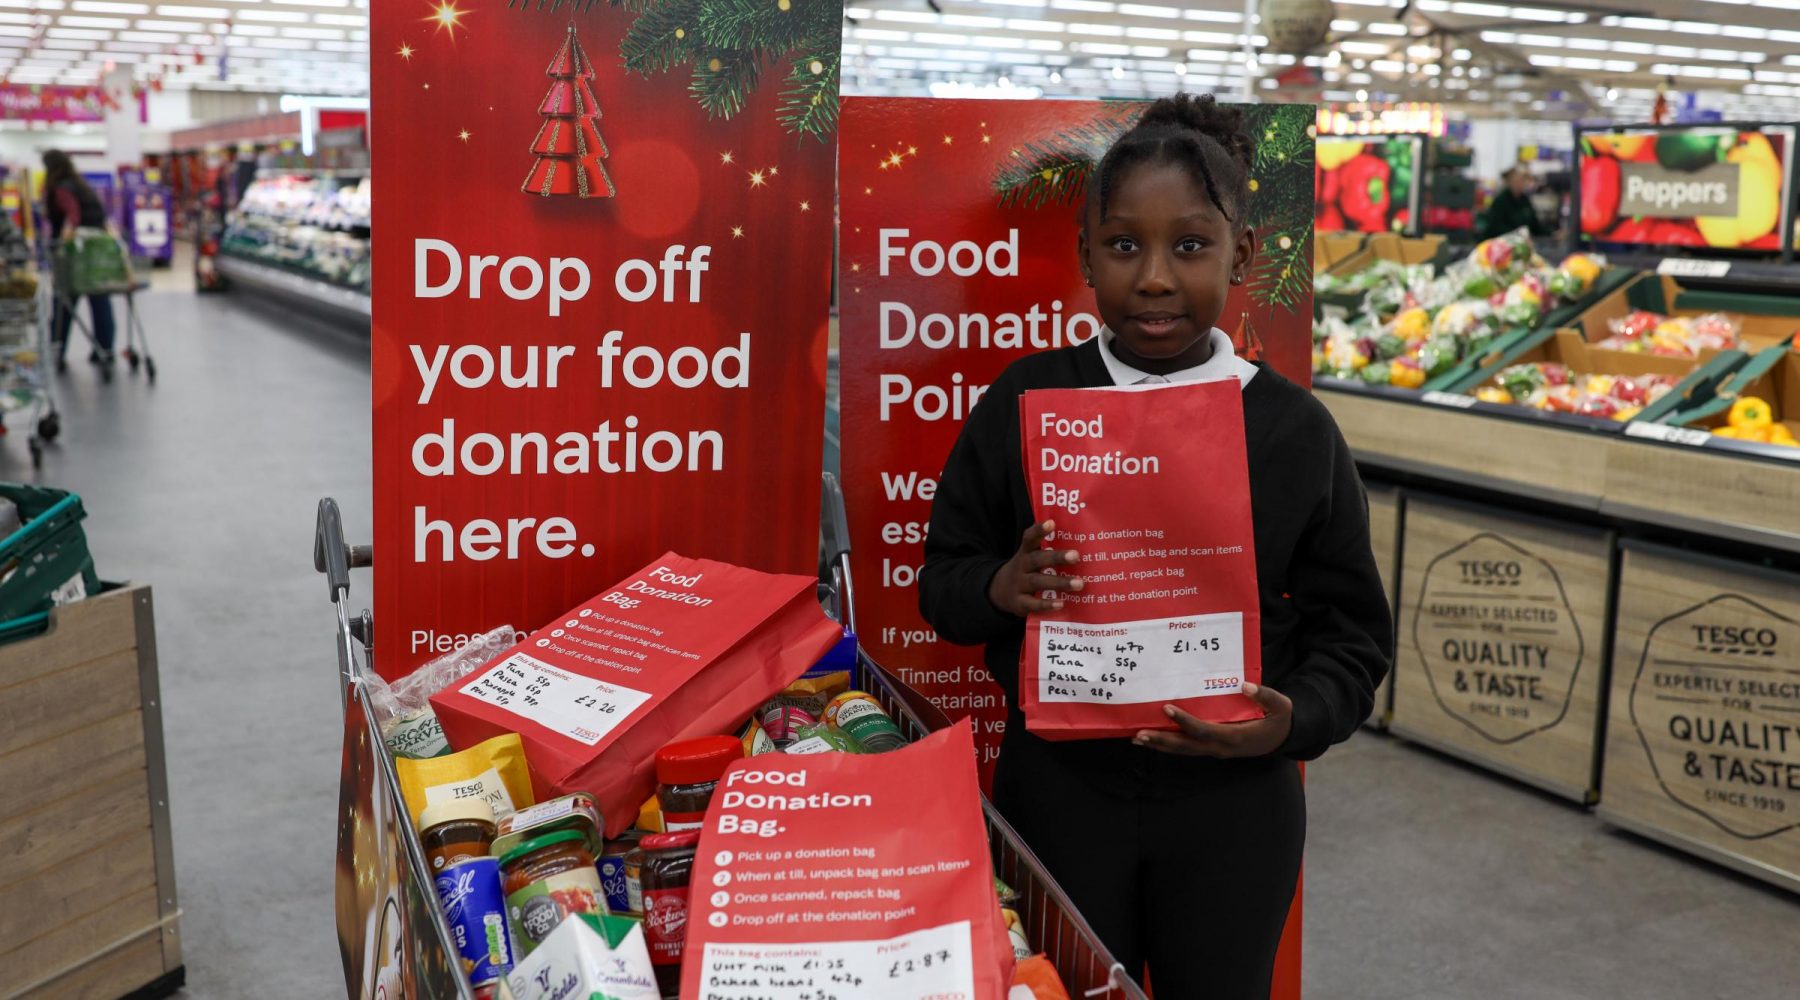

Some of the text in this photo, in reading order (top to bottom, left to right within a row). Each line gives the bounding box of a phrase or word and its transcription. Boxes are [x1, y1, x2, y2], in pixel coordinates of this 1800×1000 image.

[1627, 175, 1728, 209] Peppers
[879, 228, 1019, 277] Food
[414, 238, 711, 317] Drop off
[880, 300, 1100, 349] Donatio
[409, 330, 751, 405] your food
[880, 372, 990, 421] Poi
[1041, 413, 1103, 439] Food
[411, 415, 724, 476] donation
[1041, 448, 1159, 475] Donation
[1042, 482, 1087, 514] Bag.
[414, 505, 596, 563] here.
[1057, 528, 1164, 543] Pick up a donation bag
[1082, 553, 1092, 562] at
[1111, 549, 1146, 562] unpack
[1149, 547, 1167, 559] bag
[1169, 546, 1188, 556] and
[1190, 547, 1214, 556] scan
[1216, 545, 1243, 555] items
[648, 566, 703, 588] Food
[1130, 568, 1163, 582] repack
[1166, 567, 1185, 577] bag
[1458, 561, 1522, 579] TESCO
[602, 591, 642, 609] Bag.
[625, 580, 713, 607] Donation
[1061, 586, 1198, 604] Drop off at the donation point
[1493, 607, 1558, 623] SELECTED
[1044, 625, 1128, 637] This bag contains:
[1169, 621, 1196, 630] Price:
[882, 627, 896, 644] If
[1692, 624, 1777, 647] TESCO
[1047, 639, 1144, 654] Sardines 47p
[1173, 637, 1220, 653] £1.95
[1442, 639, 1549, 669] QUALITY
[506, 662, 525, 678] Tuna
[1047, 654, 1138, 671] Tuna 55p
[493, 670, 518, 687] Pasta
[897, 666, 960, 684] Tinned
[1048, 671, 1126, 686] Pasta 65p
[1204, 677, 1239, 687] TESCO
[1048, 685, 1113, 700] Peas 28p
[1454, 670, 1544, 700] & TASTE
[1654, 673, 1800, 699] EXPERTLY SELECT
[926, 692, 995, 709] etarian
[1722, 698, 1753, 712] FOR
[574, 726, 599, 738] TESCO
[1669, 715, 1800, 753] QUALIT
[726, 769, 807, 787] Food
[1683, 752, 1800, 791] & TASTE
[452, 781, 484, 796] TESCO
[722, 791, 872, 811] Donation
[1705, 788, 1786, 812] SINCE 1919
[717, 814, 787, 838] Bag.
[738, 847, 876, 863] Pick up a donation bag
[736, 871, 772, 882] When
[774, 871, 787, 881] at
[810, 868, 854, 880] unpack
[857, 867, 879, 878] bag
[882, 866, 904, 877] and
[907, 864, 935, 875] scan
[937, 859, 970, 871] items
[735, 893, 768, 904] Once
[831, 888, 874, 900] repack
[877, 887, 901, 899] bag
[733, 906, 916, 926] Drop off at the donation point
[713, 963, 746, 971] UHT
